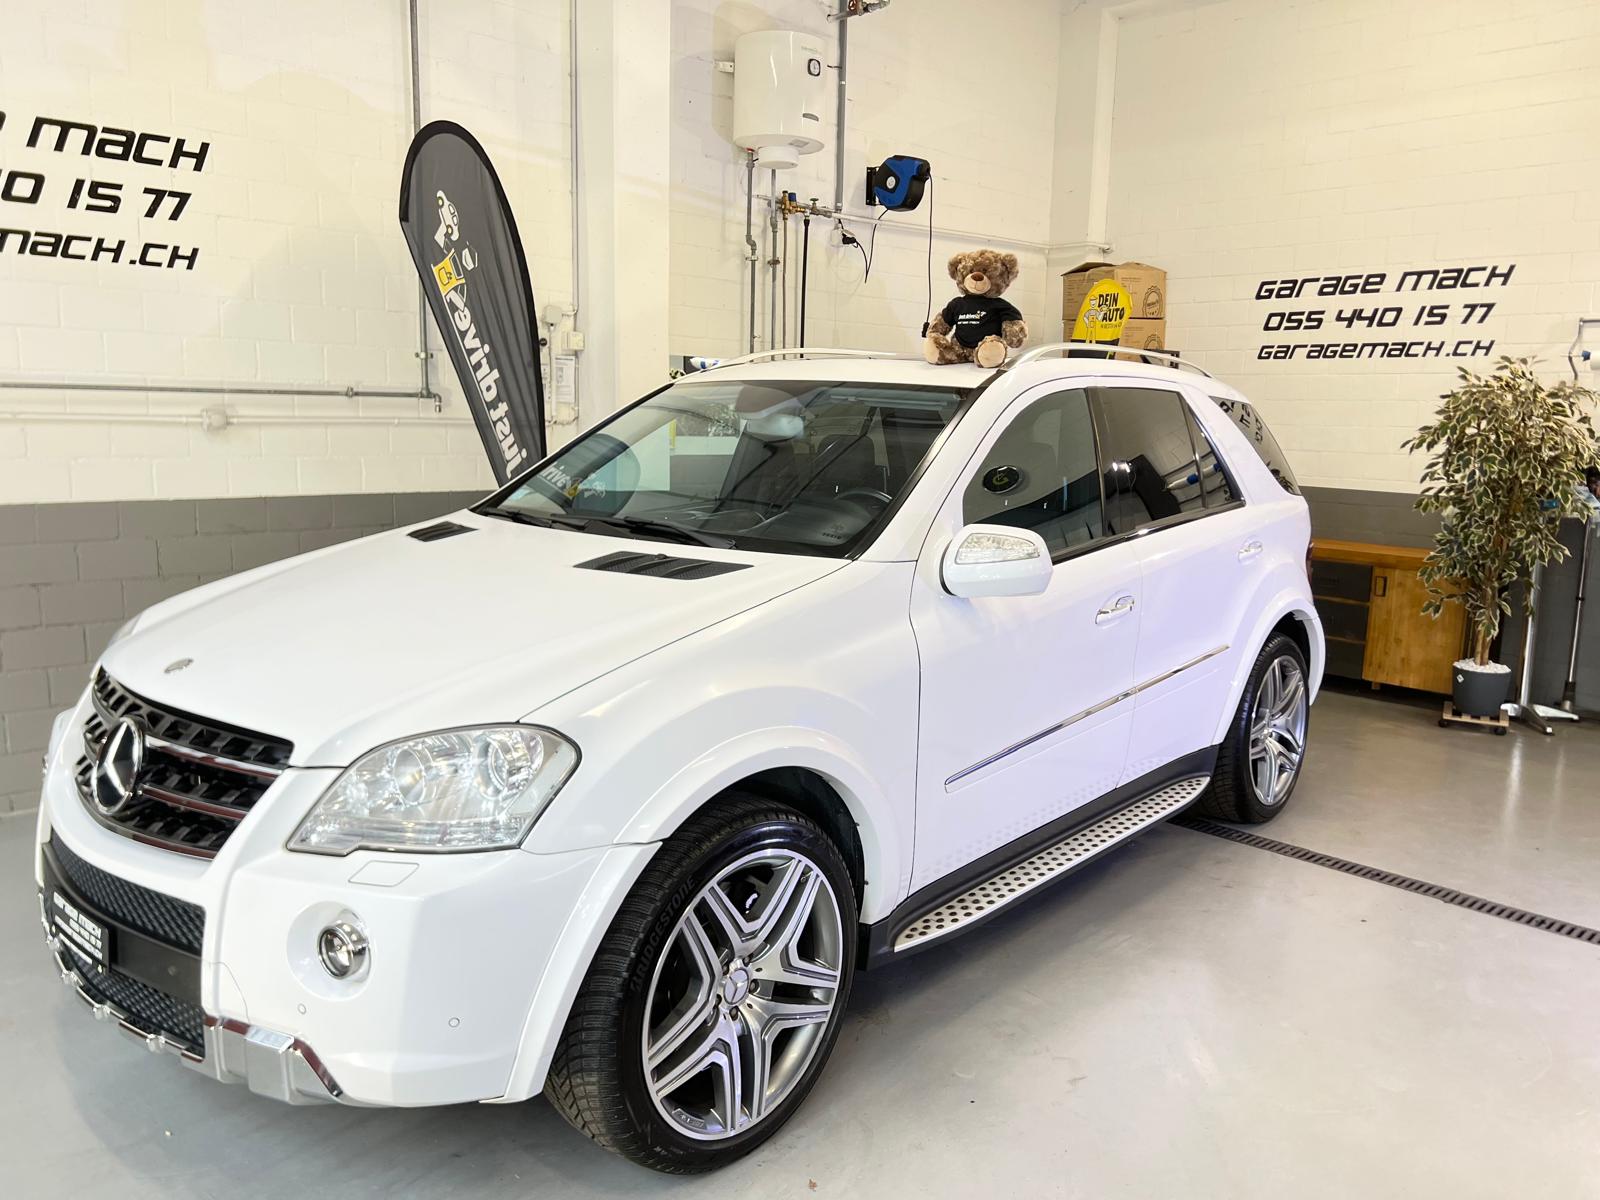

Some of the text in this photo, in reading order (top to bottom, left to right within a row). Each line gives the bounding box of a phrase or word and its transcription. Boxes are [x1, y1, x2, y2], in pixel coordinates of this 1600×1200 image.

[66, 178, 124, 214] 15
[142, 187, 192, 221] 77
[1097, 292, 1119, 308] DEIN
[1101, 307, 1125, 323] AUTO
[1262, 302, 1497, 331] 055 440 15 77
